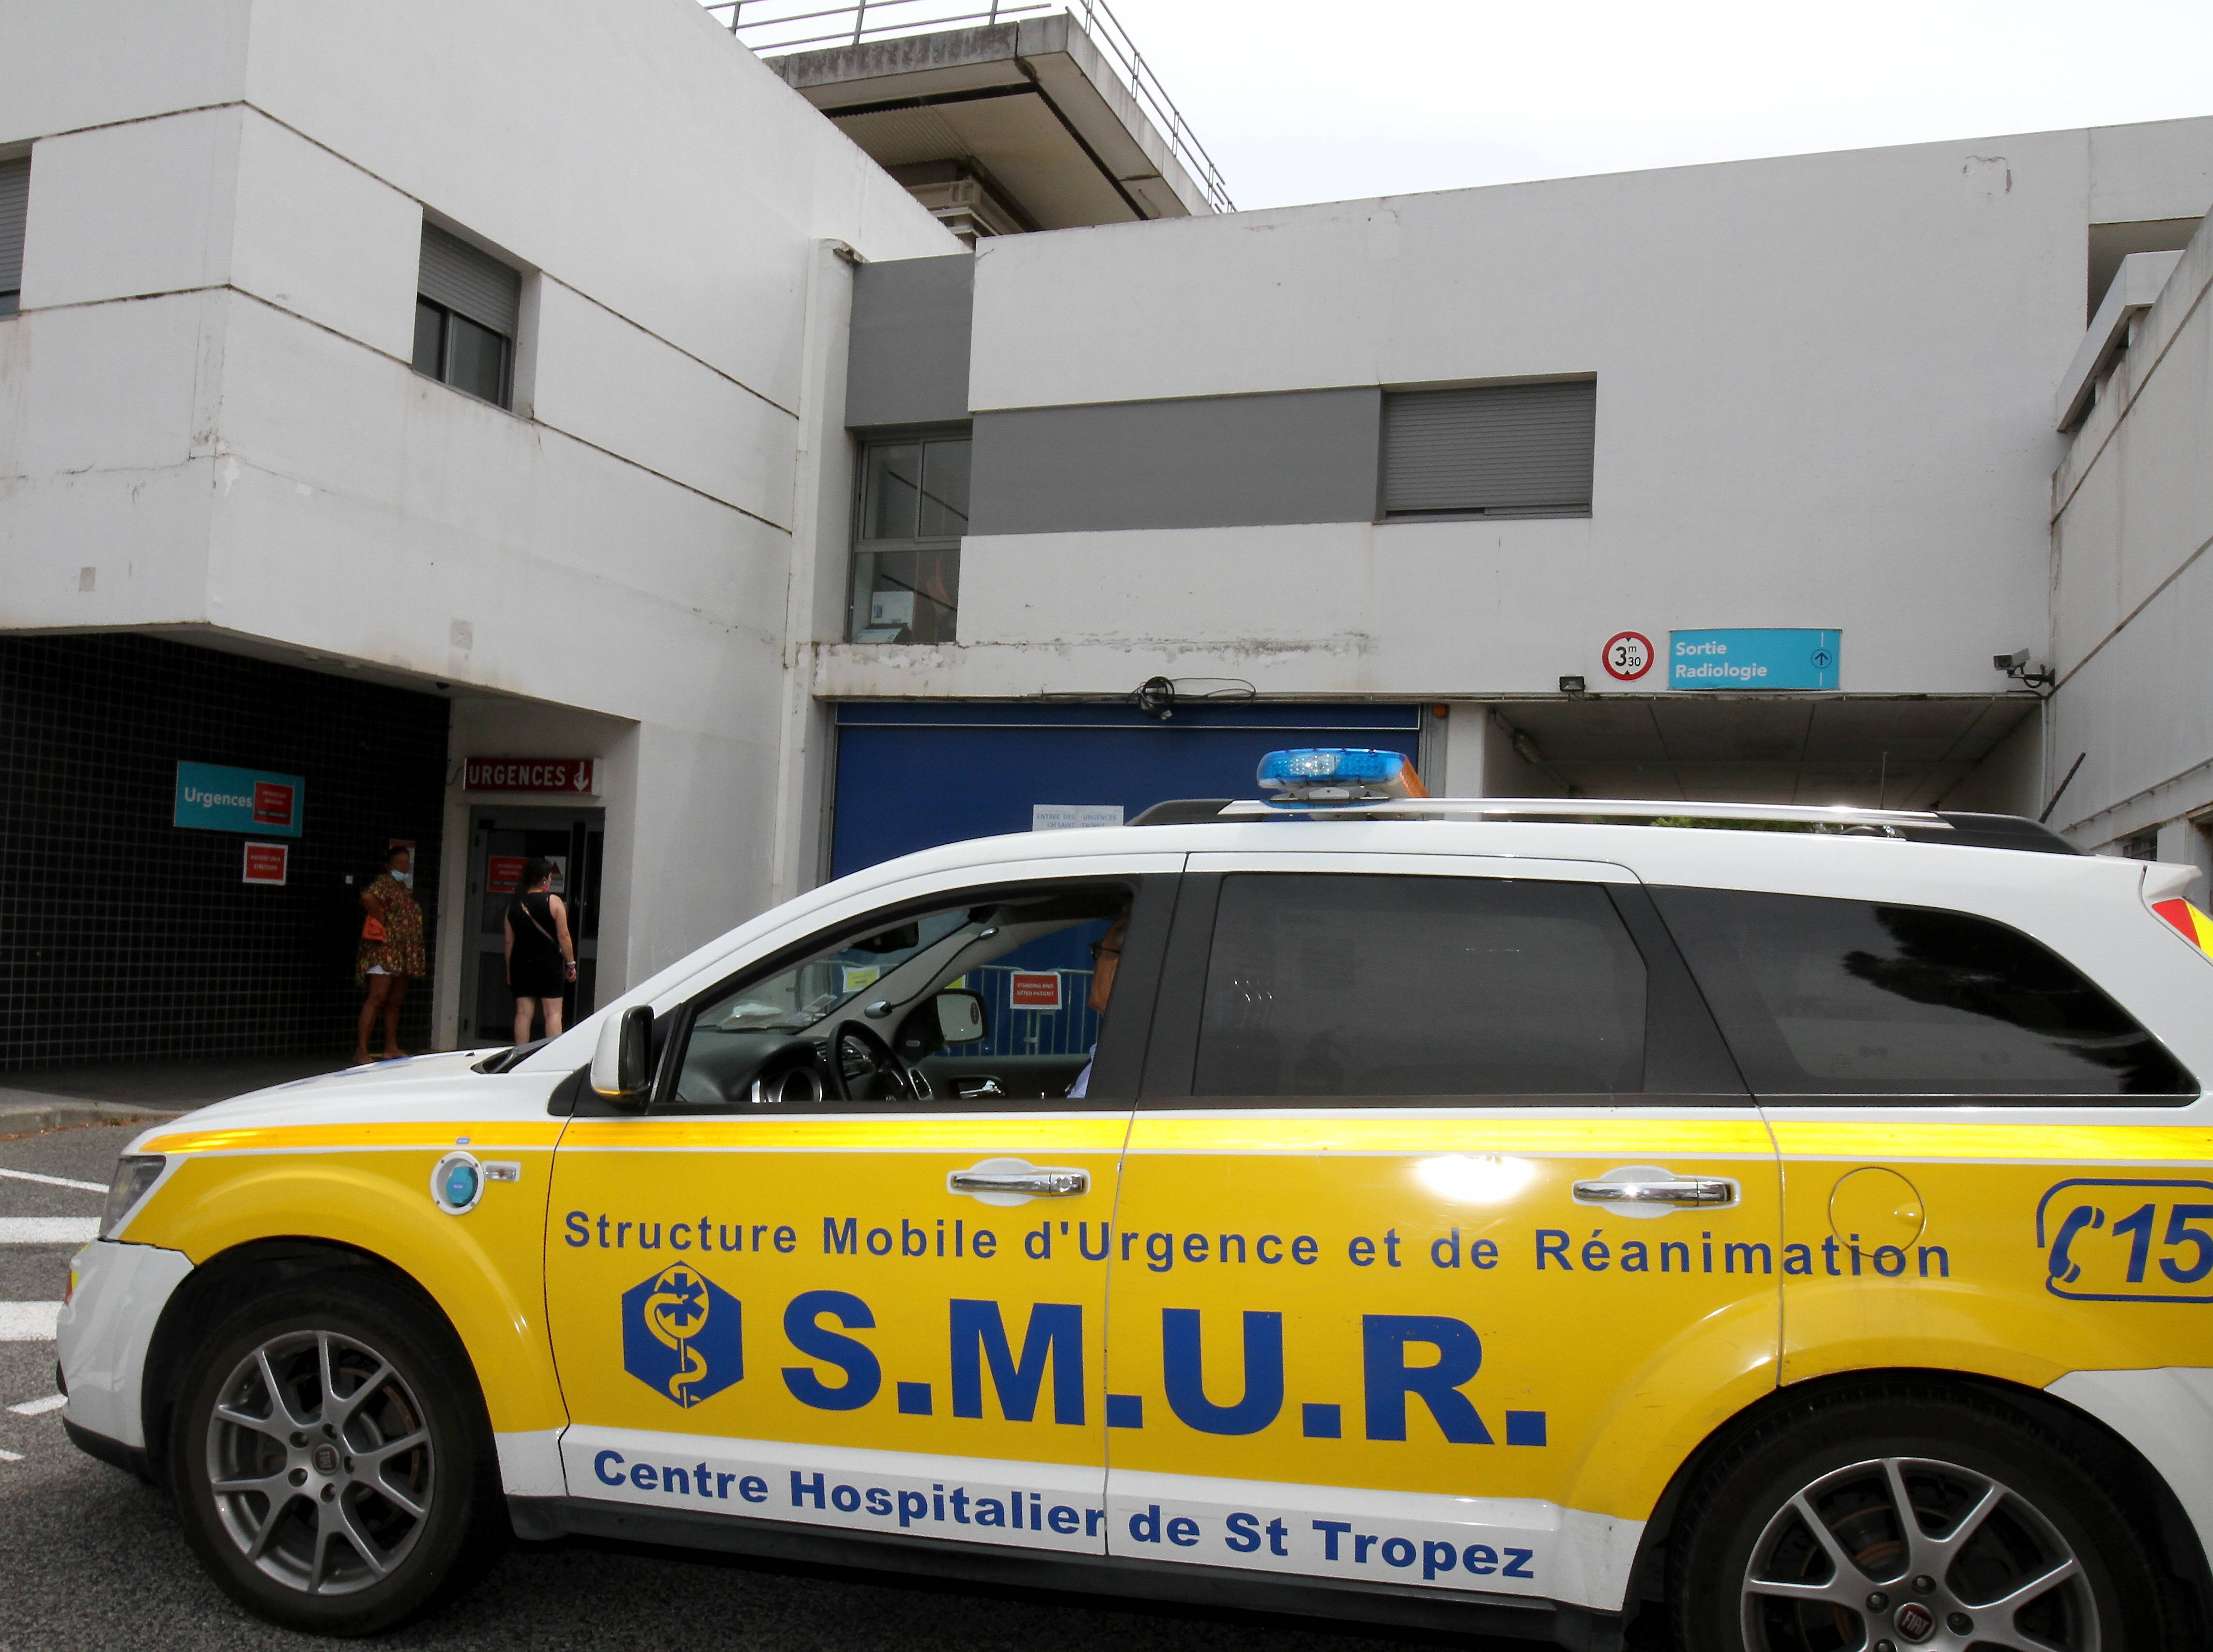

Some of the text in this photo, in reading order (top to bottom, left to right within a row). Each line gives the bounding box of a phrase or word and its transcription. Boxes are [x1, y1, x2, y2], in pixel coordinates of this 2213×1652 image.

[1675, 640, 1727, 655] Sortie
[1675, 662, 1767, 680] Radiologie
[468, 764, 567, 787] URGENCES
[184, 787, 252, 808] Urgences
[565, 1210, 1950, 1278] Structure Mobile d'Urgence et de Réanimation
[2111, 1203, 2213, 1284] 15
[781, 1289, 1547, 1447] S.M.U.R.
[593, 1449, 1534, 1580] Centre Hospitalier de St Tropez
[1901, 1610, 1929, 1636] FIAT
